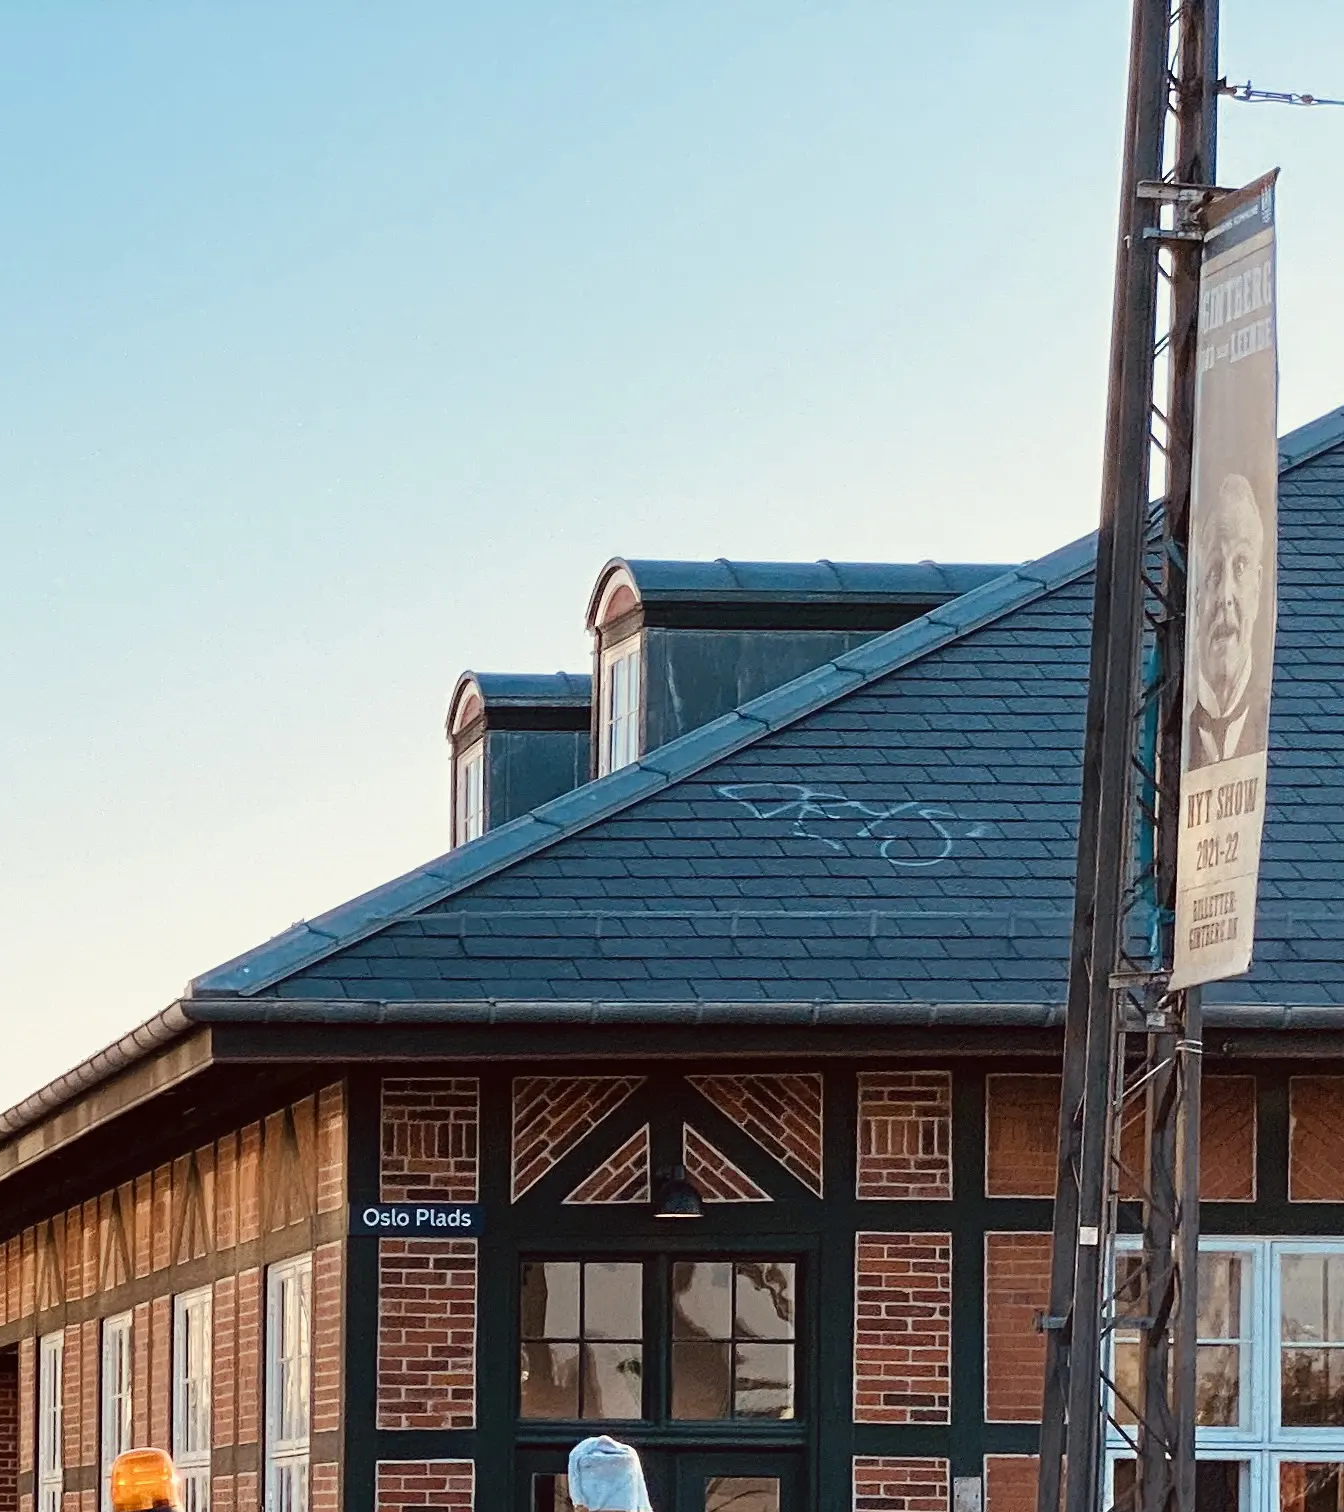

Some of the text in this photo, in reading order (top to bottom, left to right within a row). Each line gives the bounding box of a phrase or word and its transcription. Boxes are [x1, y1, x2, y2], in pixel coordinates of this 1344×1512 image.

[1188, 777, 1258, 829] NYT SHOW
[1196, 831, 1240, 871] 2021-22
[362, 1207, 472, 1228] Oslo Plads
